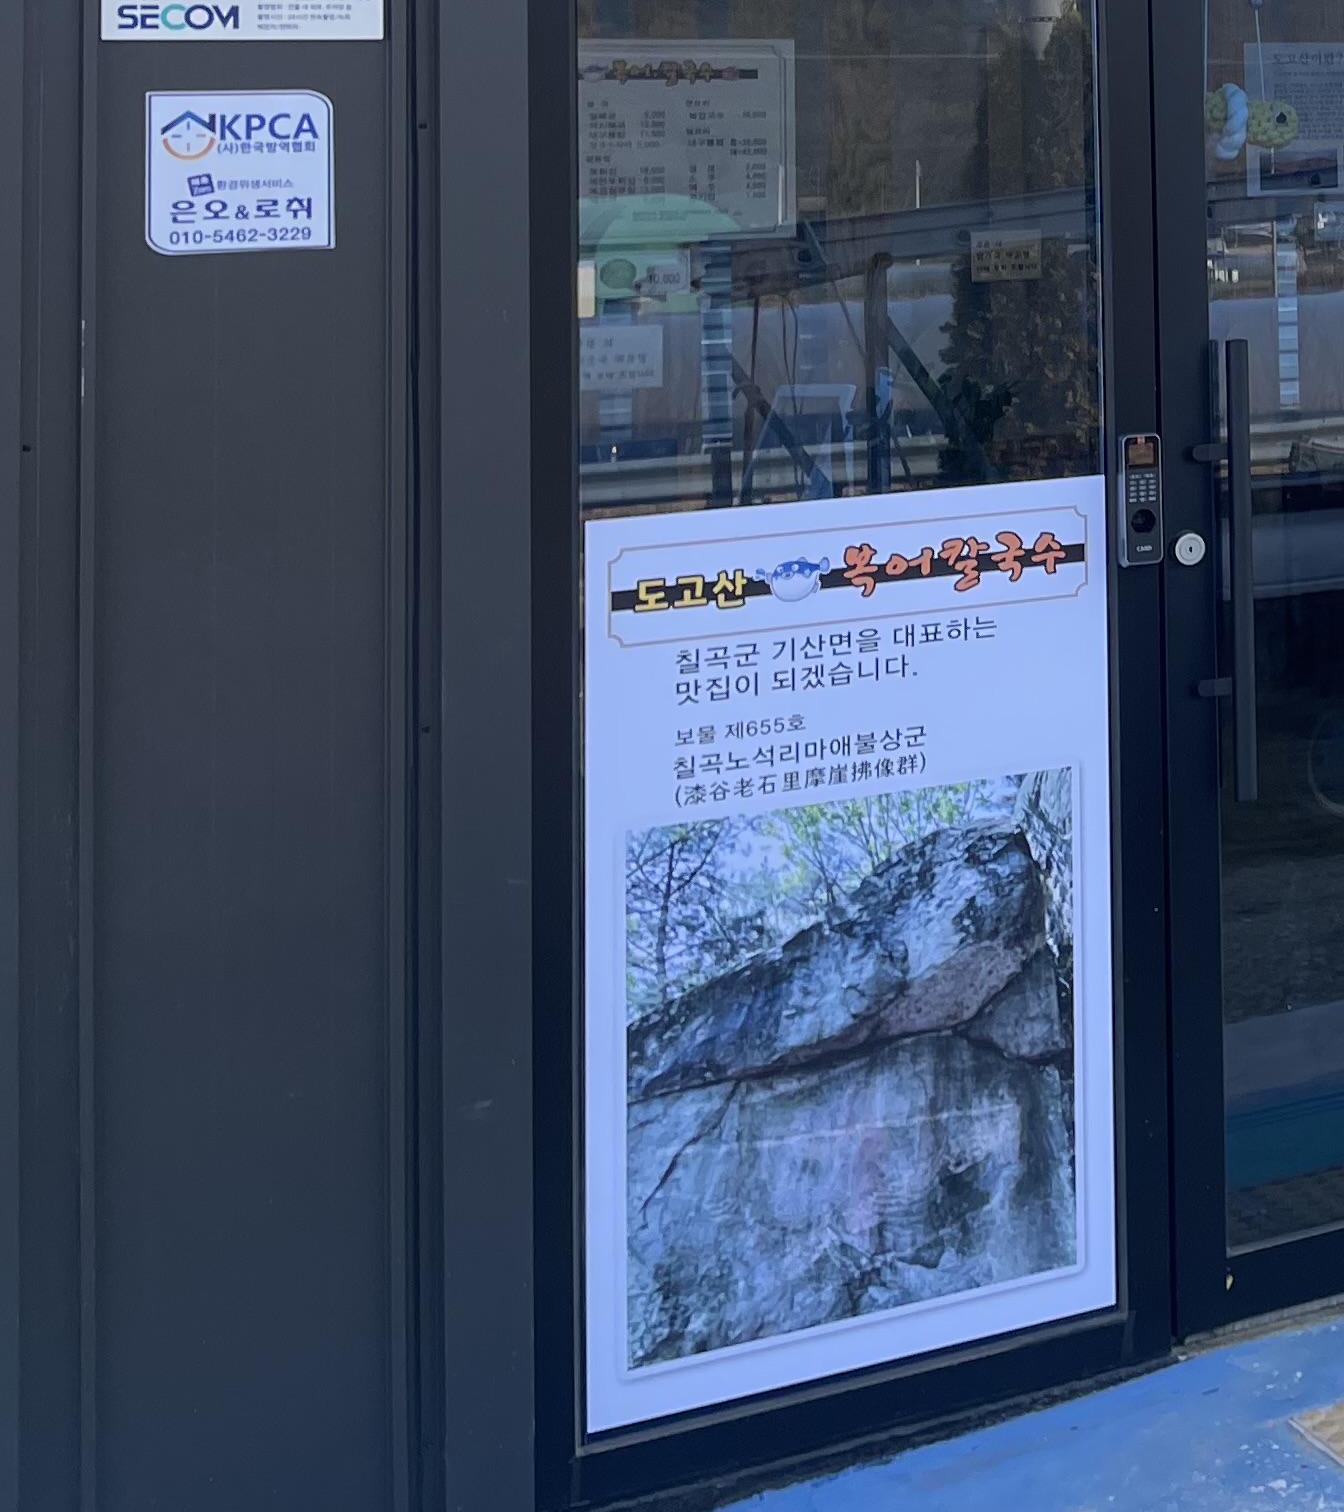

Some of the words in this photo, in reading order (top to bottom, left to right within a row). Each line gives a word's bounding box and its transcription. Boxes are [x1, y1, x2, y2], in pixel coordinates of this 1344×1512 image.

[117, 3, 240, 31] SECOM
[219, 113, 319, 141] KPCA
[169, 227, 312, 245] 010-5462-3229
[633, 568, 749, 614] 도고산
[842, 530, 1067, 598] 복어칼국수
[675, 643, 761, 675] 칠곡군
[772, 627, 882, 662] 기산면을
[893, 614, 998, 649] 대표하는
[675, 672, 759, 706] 맛집이
[771, 654, 919, 692] 되겠습니다.
[674, 725, 717, 747] 보물
[724, 714, 807, 740] 제655호
[673, 725, 928, 780] 칠곡노석리마애불상군
